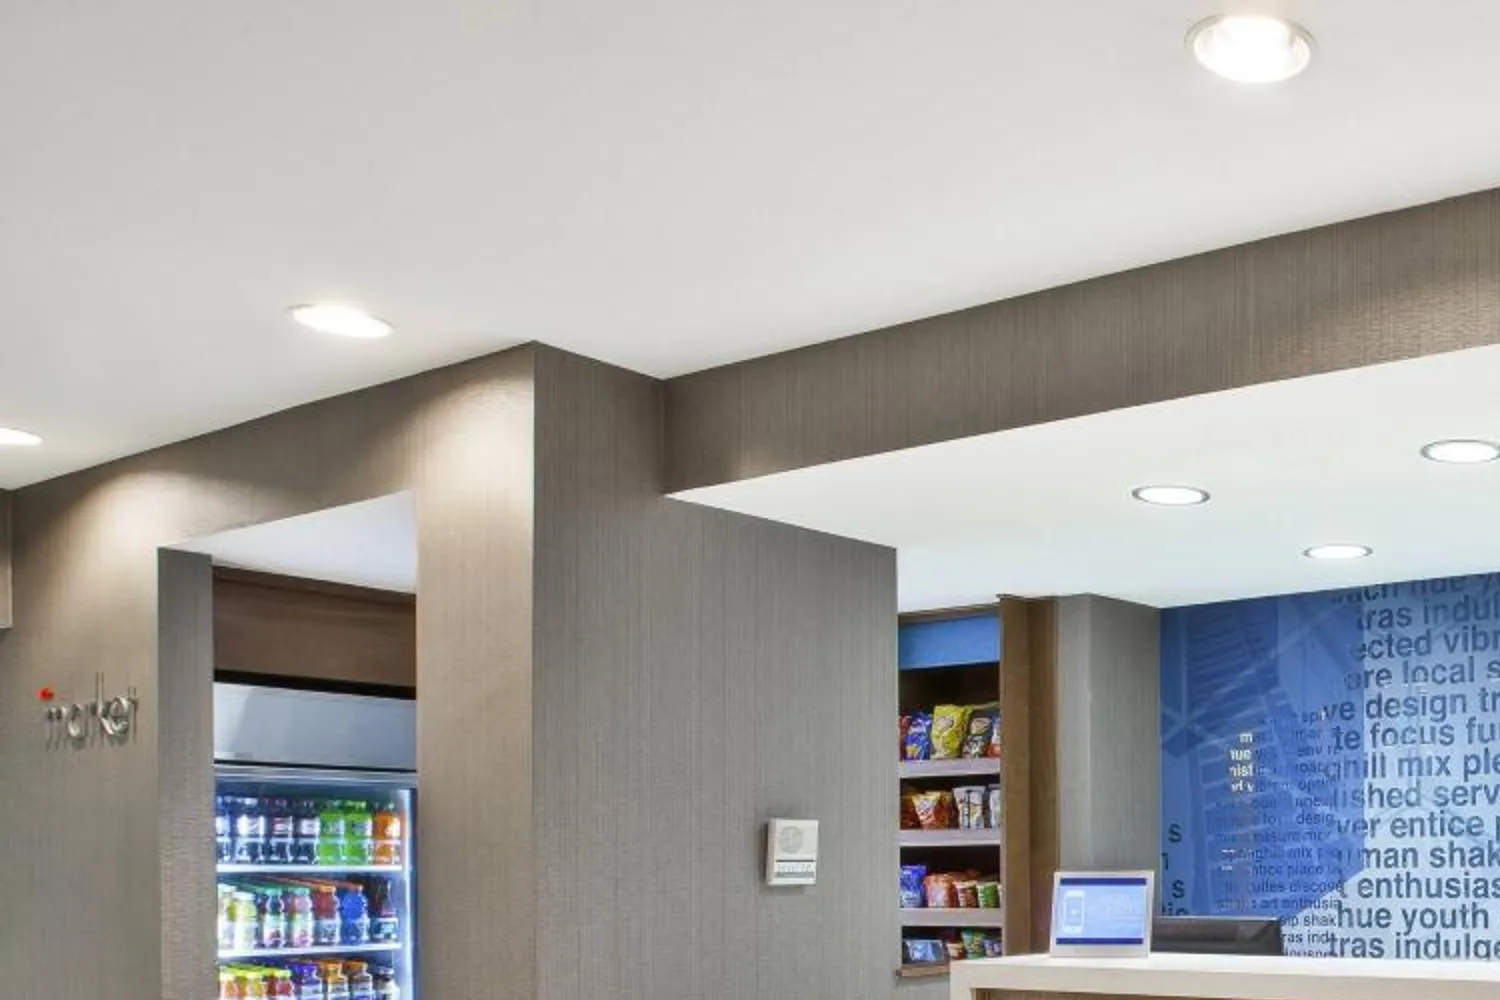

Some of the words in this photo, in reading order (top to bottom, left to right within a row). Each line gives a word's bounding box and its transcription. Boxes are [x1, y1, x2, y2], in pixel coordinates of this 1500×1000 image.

[1403, 655, 1476, 685] local
[1366, 692, 1467, 723] design
[1334, 725, 1361, 750] te
[1370, 722, 1456, 748] focus
[1397, 754, 1451, 778] mix
[1390, 810, 1485, 838] entice
[1337, 900, 1393, 929] hue
[1401, 902, 1490, 936] youth
[1327, 934, 1385, 961] tras
